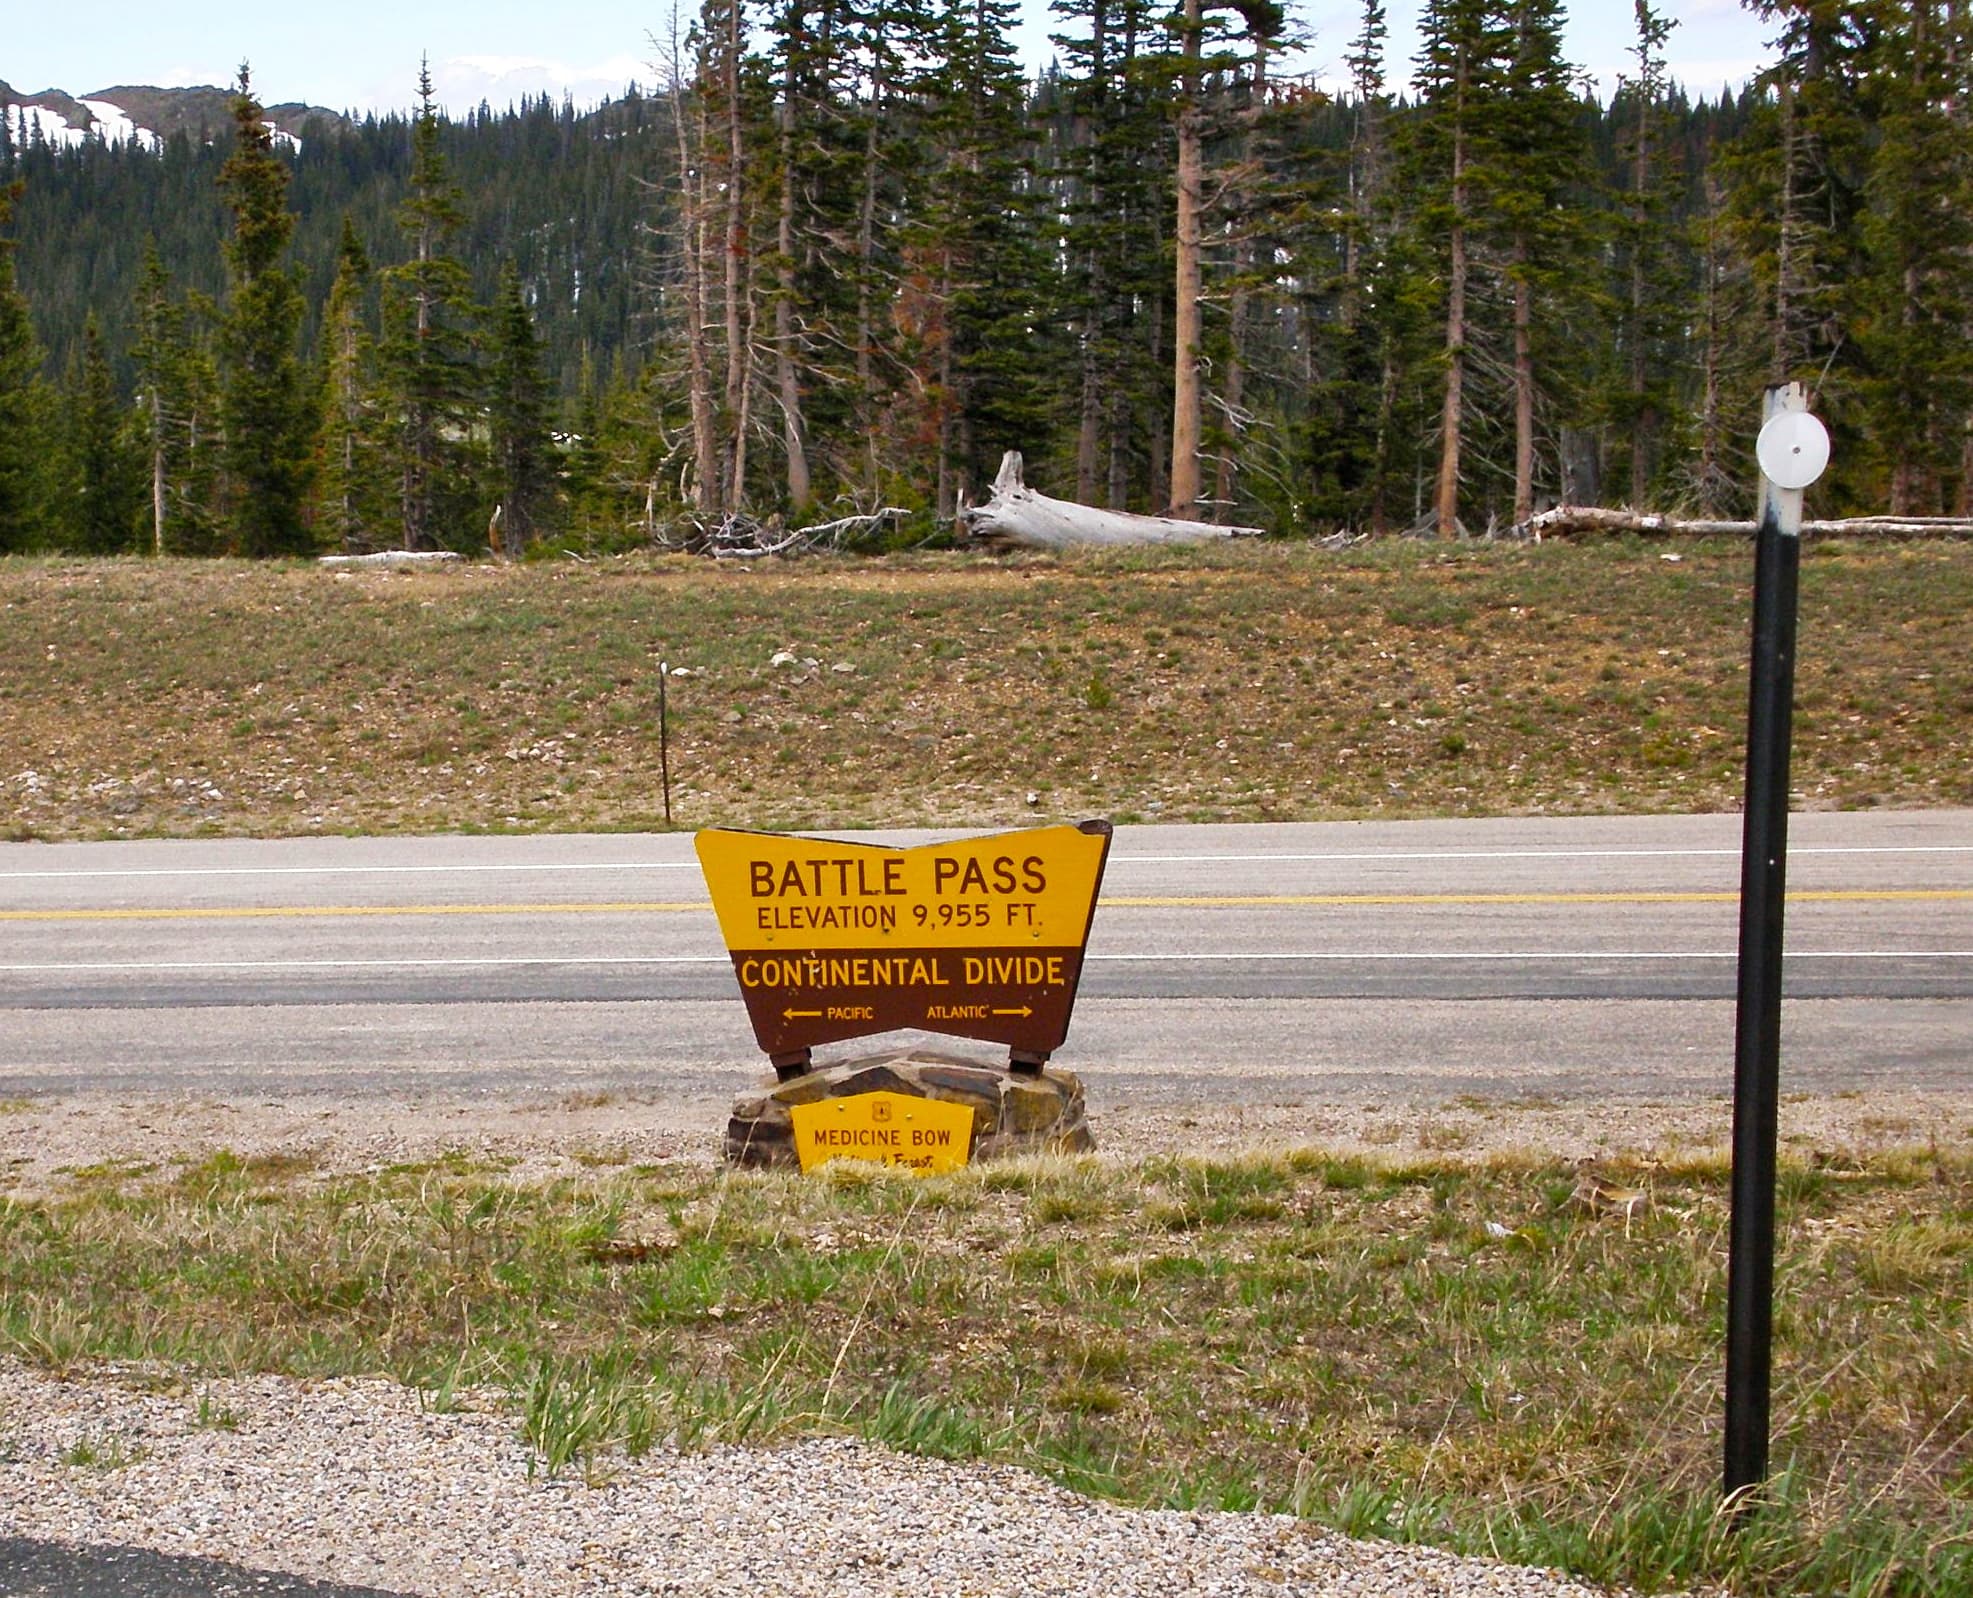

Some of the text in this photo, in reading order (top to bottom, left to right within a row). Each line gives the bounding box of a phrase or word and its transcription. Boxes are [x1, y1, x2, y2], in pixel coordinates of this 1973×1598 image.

[750, 856, 1047, 897] BATTLE PASS
[757, 903, 1043, 930] ELEVATION 9,955 FT.
[741, 956, 1064, 987] CONTINENTAL DIVIDE
[827, 1006, 875, 1020] PACIFIC
[926, 1005, 988, 1019] ATLANTIC
[814, 1129, 951, 1146] MEDICINE BOW
